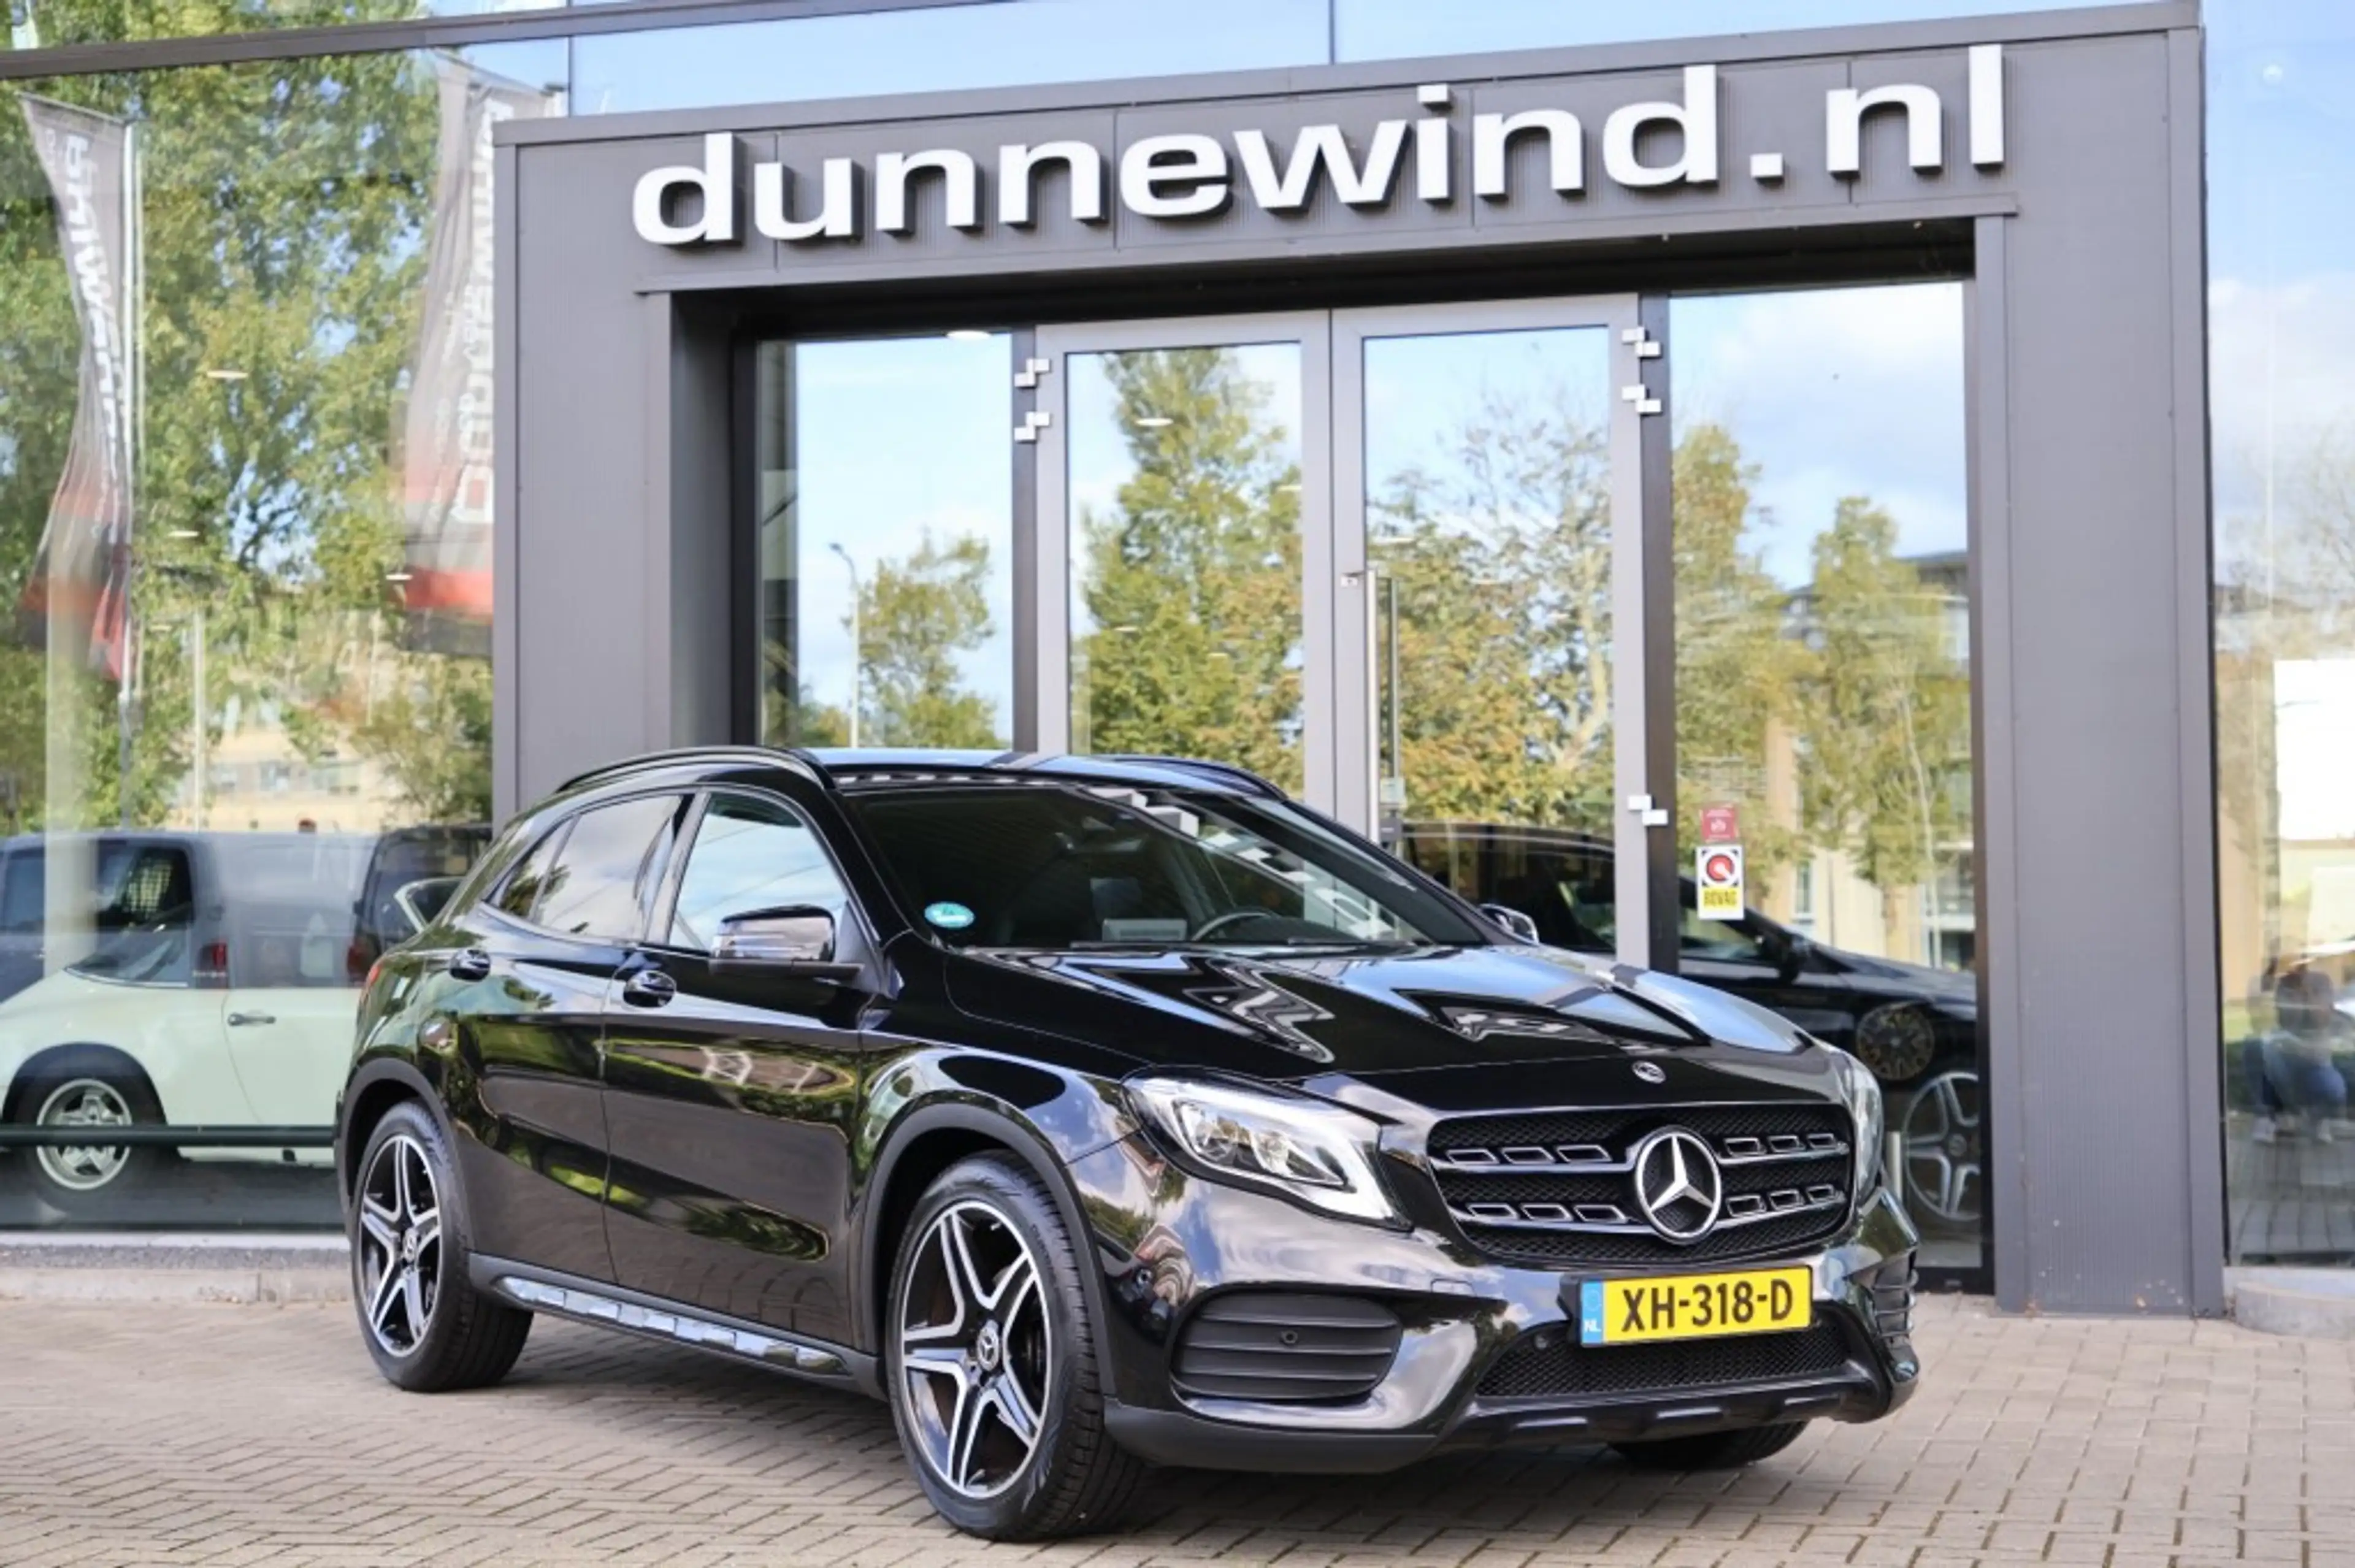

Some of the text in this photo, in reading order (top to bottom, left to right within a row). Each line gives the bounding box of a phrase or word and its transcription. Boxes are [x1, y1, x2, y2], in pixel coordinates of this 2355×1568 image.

[632, 44, 2005, 245] dunnewind.nl
[1584, 1319, 1601, 1333] NL
[1621, 1279, 1793, 1333] XH-318-D
